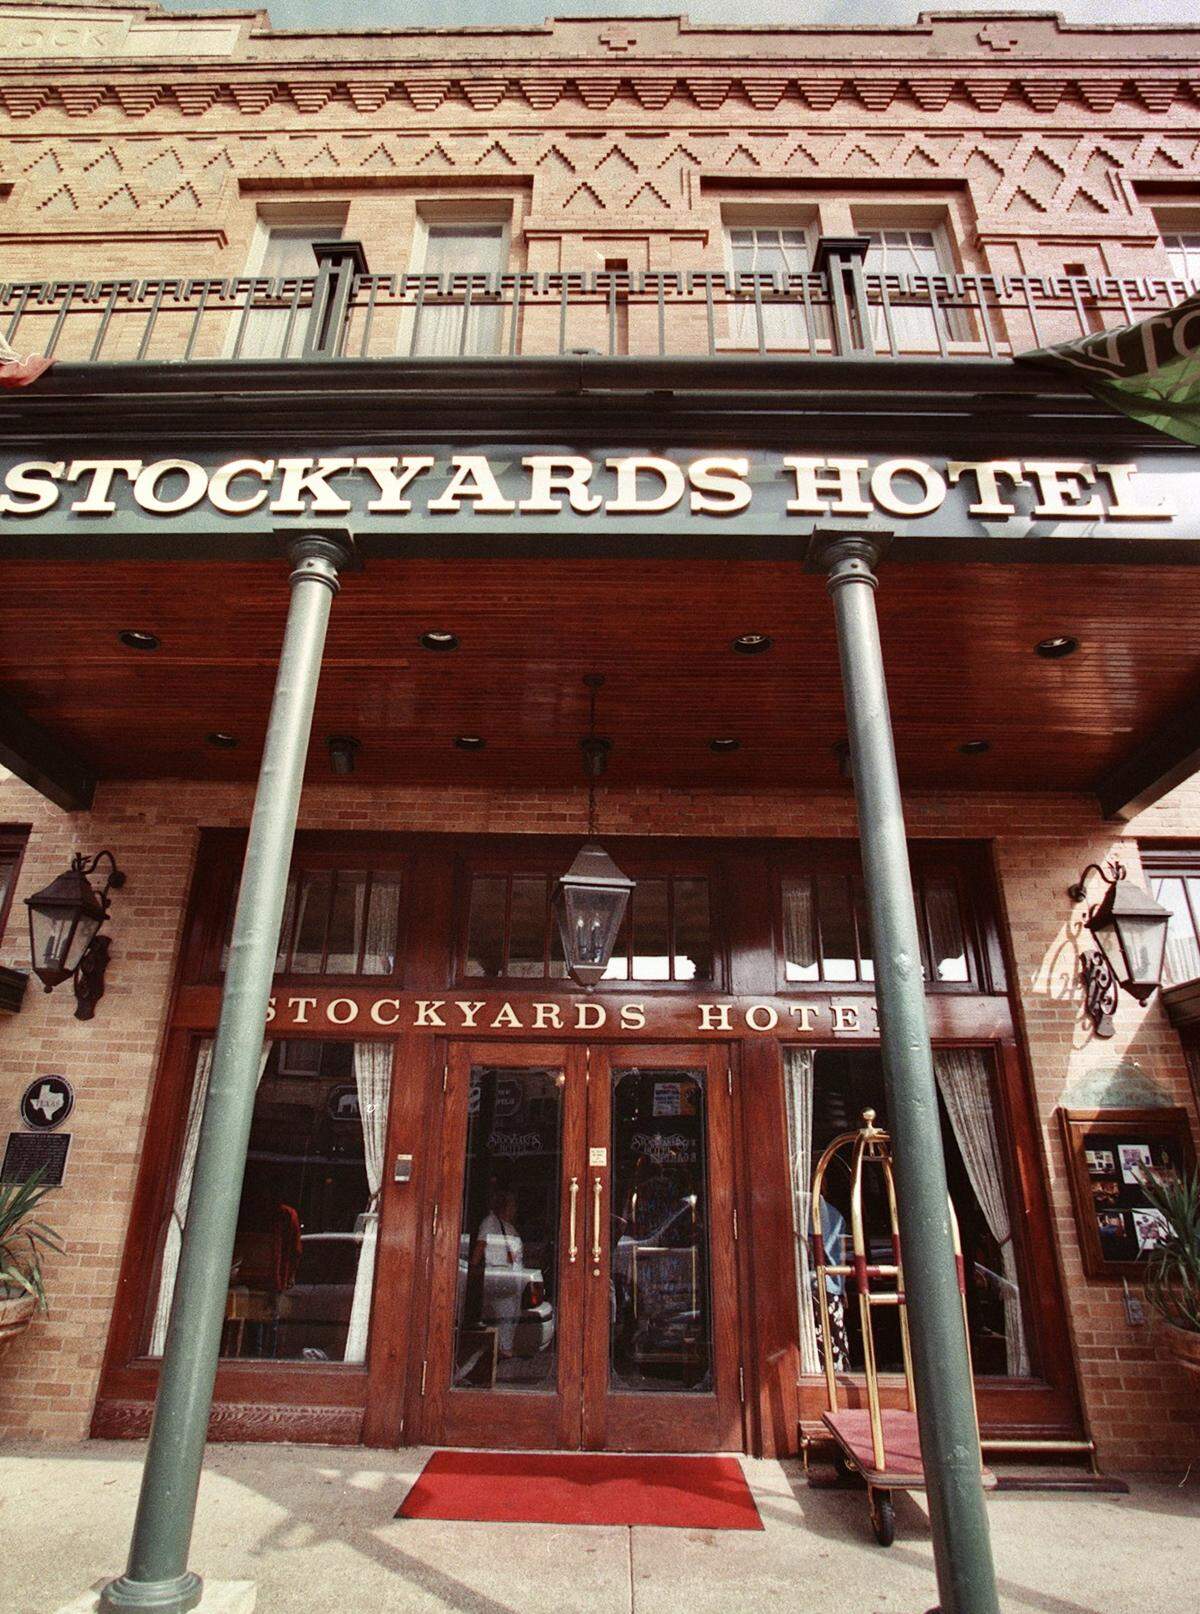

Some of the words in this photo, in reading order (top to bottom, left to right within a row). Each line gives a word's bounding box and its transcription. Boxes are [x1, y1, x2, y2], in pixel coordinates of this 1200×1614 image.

[0, 28, 109, 48] OCK
[0, 454, 753, 515] STOCKYARDS
[782, 455, 1173, 518] HOTEL
